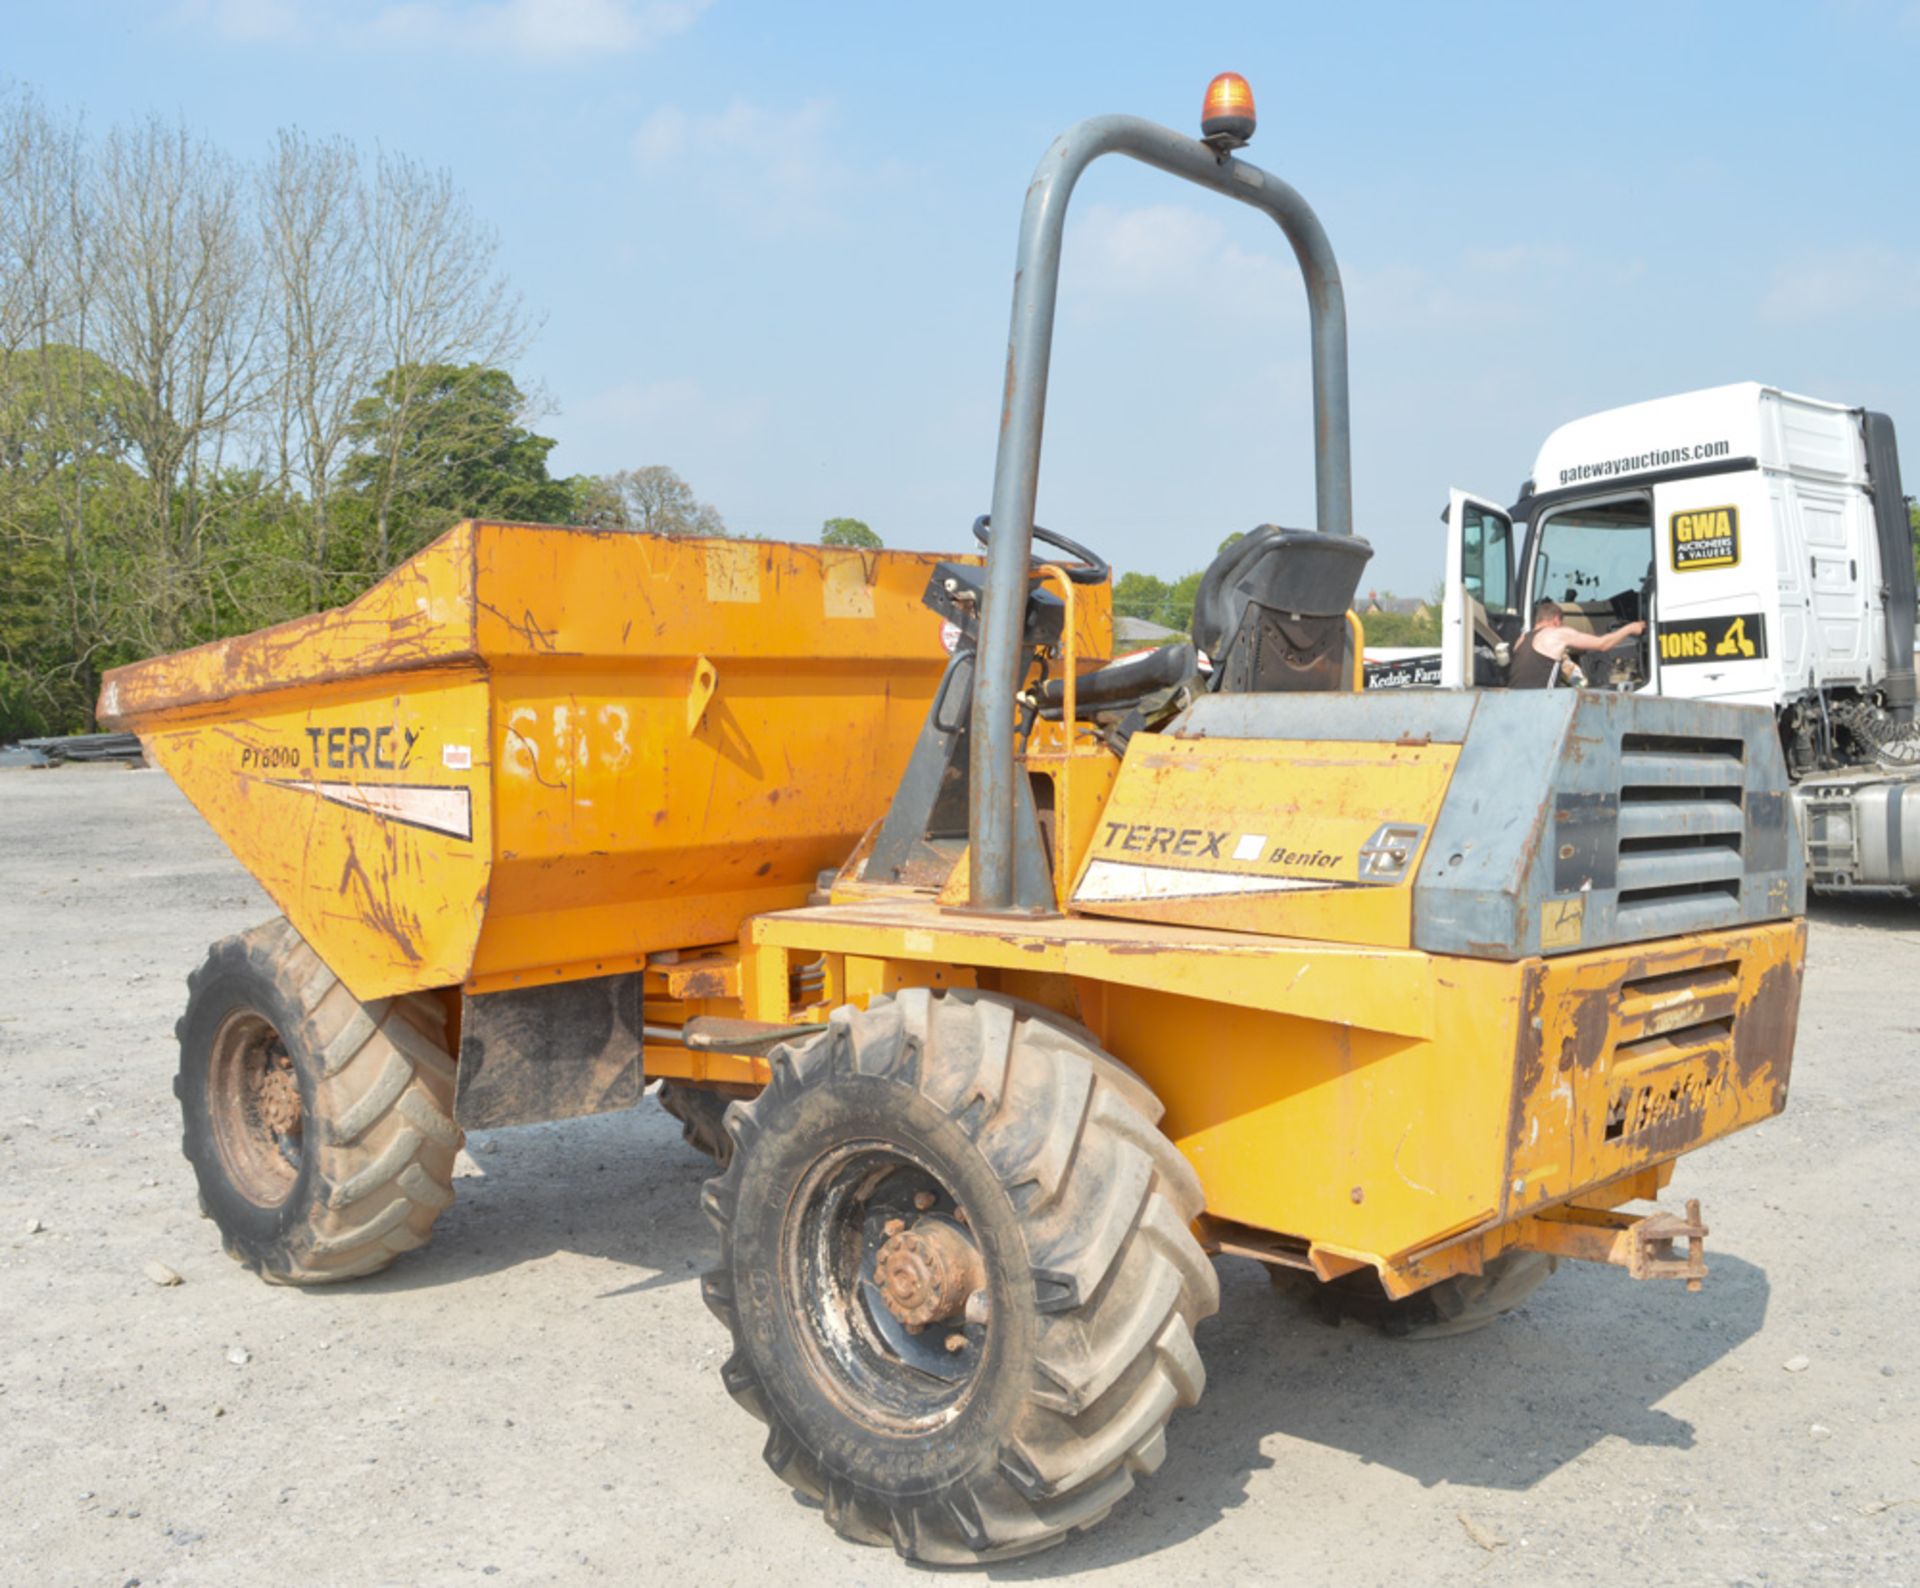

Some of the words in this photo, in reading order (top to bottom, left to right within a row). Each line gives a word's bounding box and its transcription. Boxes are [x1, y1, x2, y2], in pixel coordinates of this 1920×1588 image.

[1559, 440, 1729, 485] gatewayauctions.com
[1676, 511, 1732, 543] GWA
[1689, 547, 1732, 559] VALUERS
[241, 748, 300, 769] PT6000
[1104, 821, 1230, 859] TEREX
